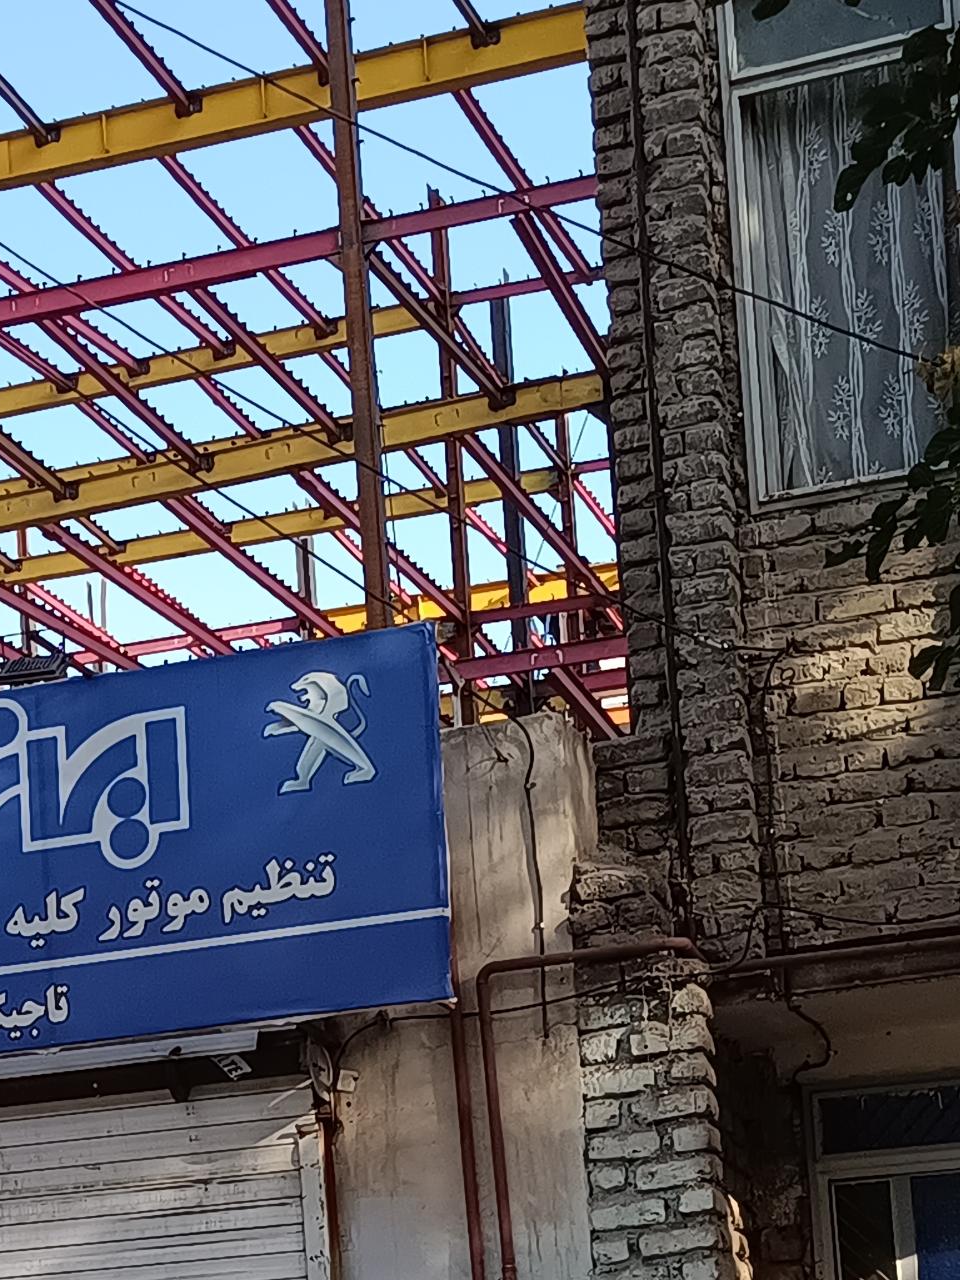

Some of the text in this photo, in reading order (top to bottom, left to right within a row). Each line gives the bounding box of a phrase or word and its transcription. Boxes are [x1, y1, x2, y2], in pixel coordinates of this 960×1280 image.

[5, 887, 85, 948] کلیه
[98, 879, 210, 941] موتور
[223, 854, 336, 924] تنظیم
